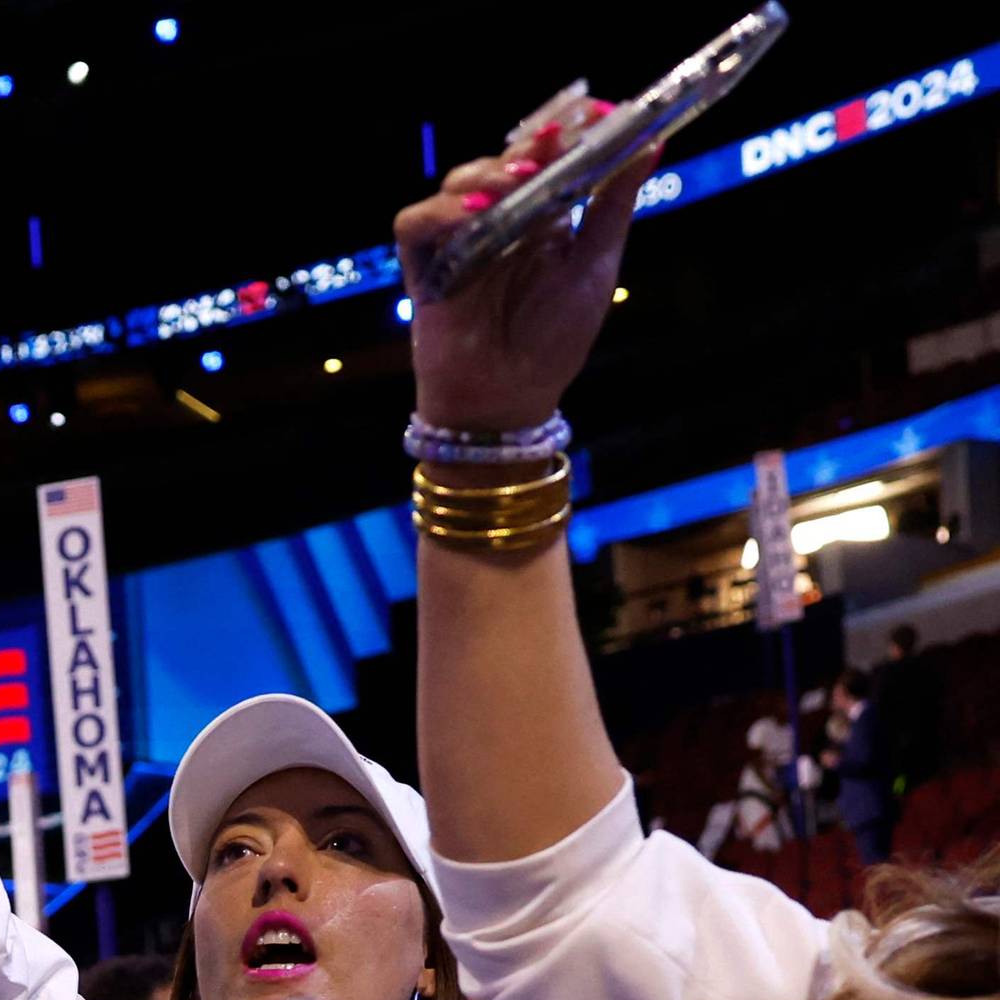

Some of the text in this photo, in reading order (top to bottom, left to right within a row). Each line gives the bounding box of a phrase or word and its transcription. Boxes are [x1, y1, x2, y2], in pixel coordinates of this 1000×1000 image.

[741, 110, 836, 177] DNC
[865, 58, 979, 130] 2024
[58, 526, 113, 824] OKLAHOMA
